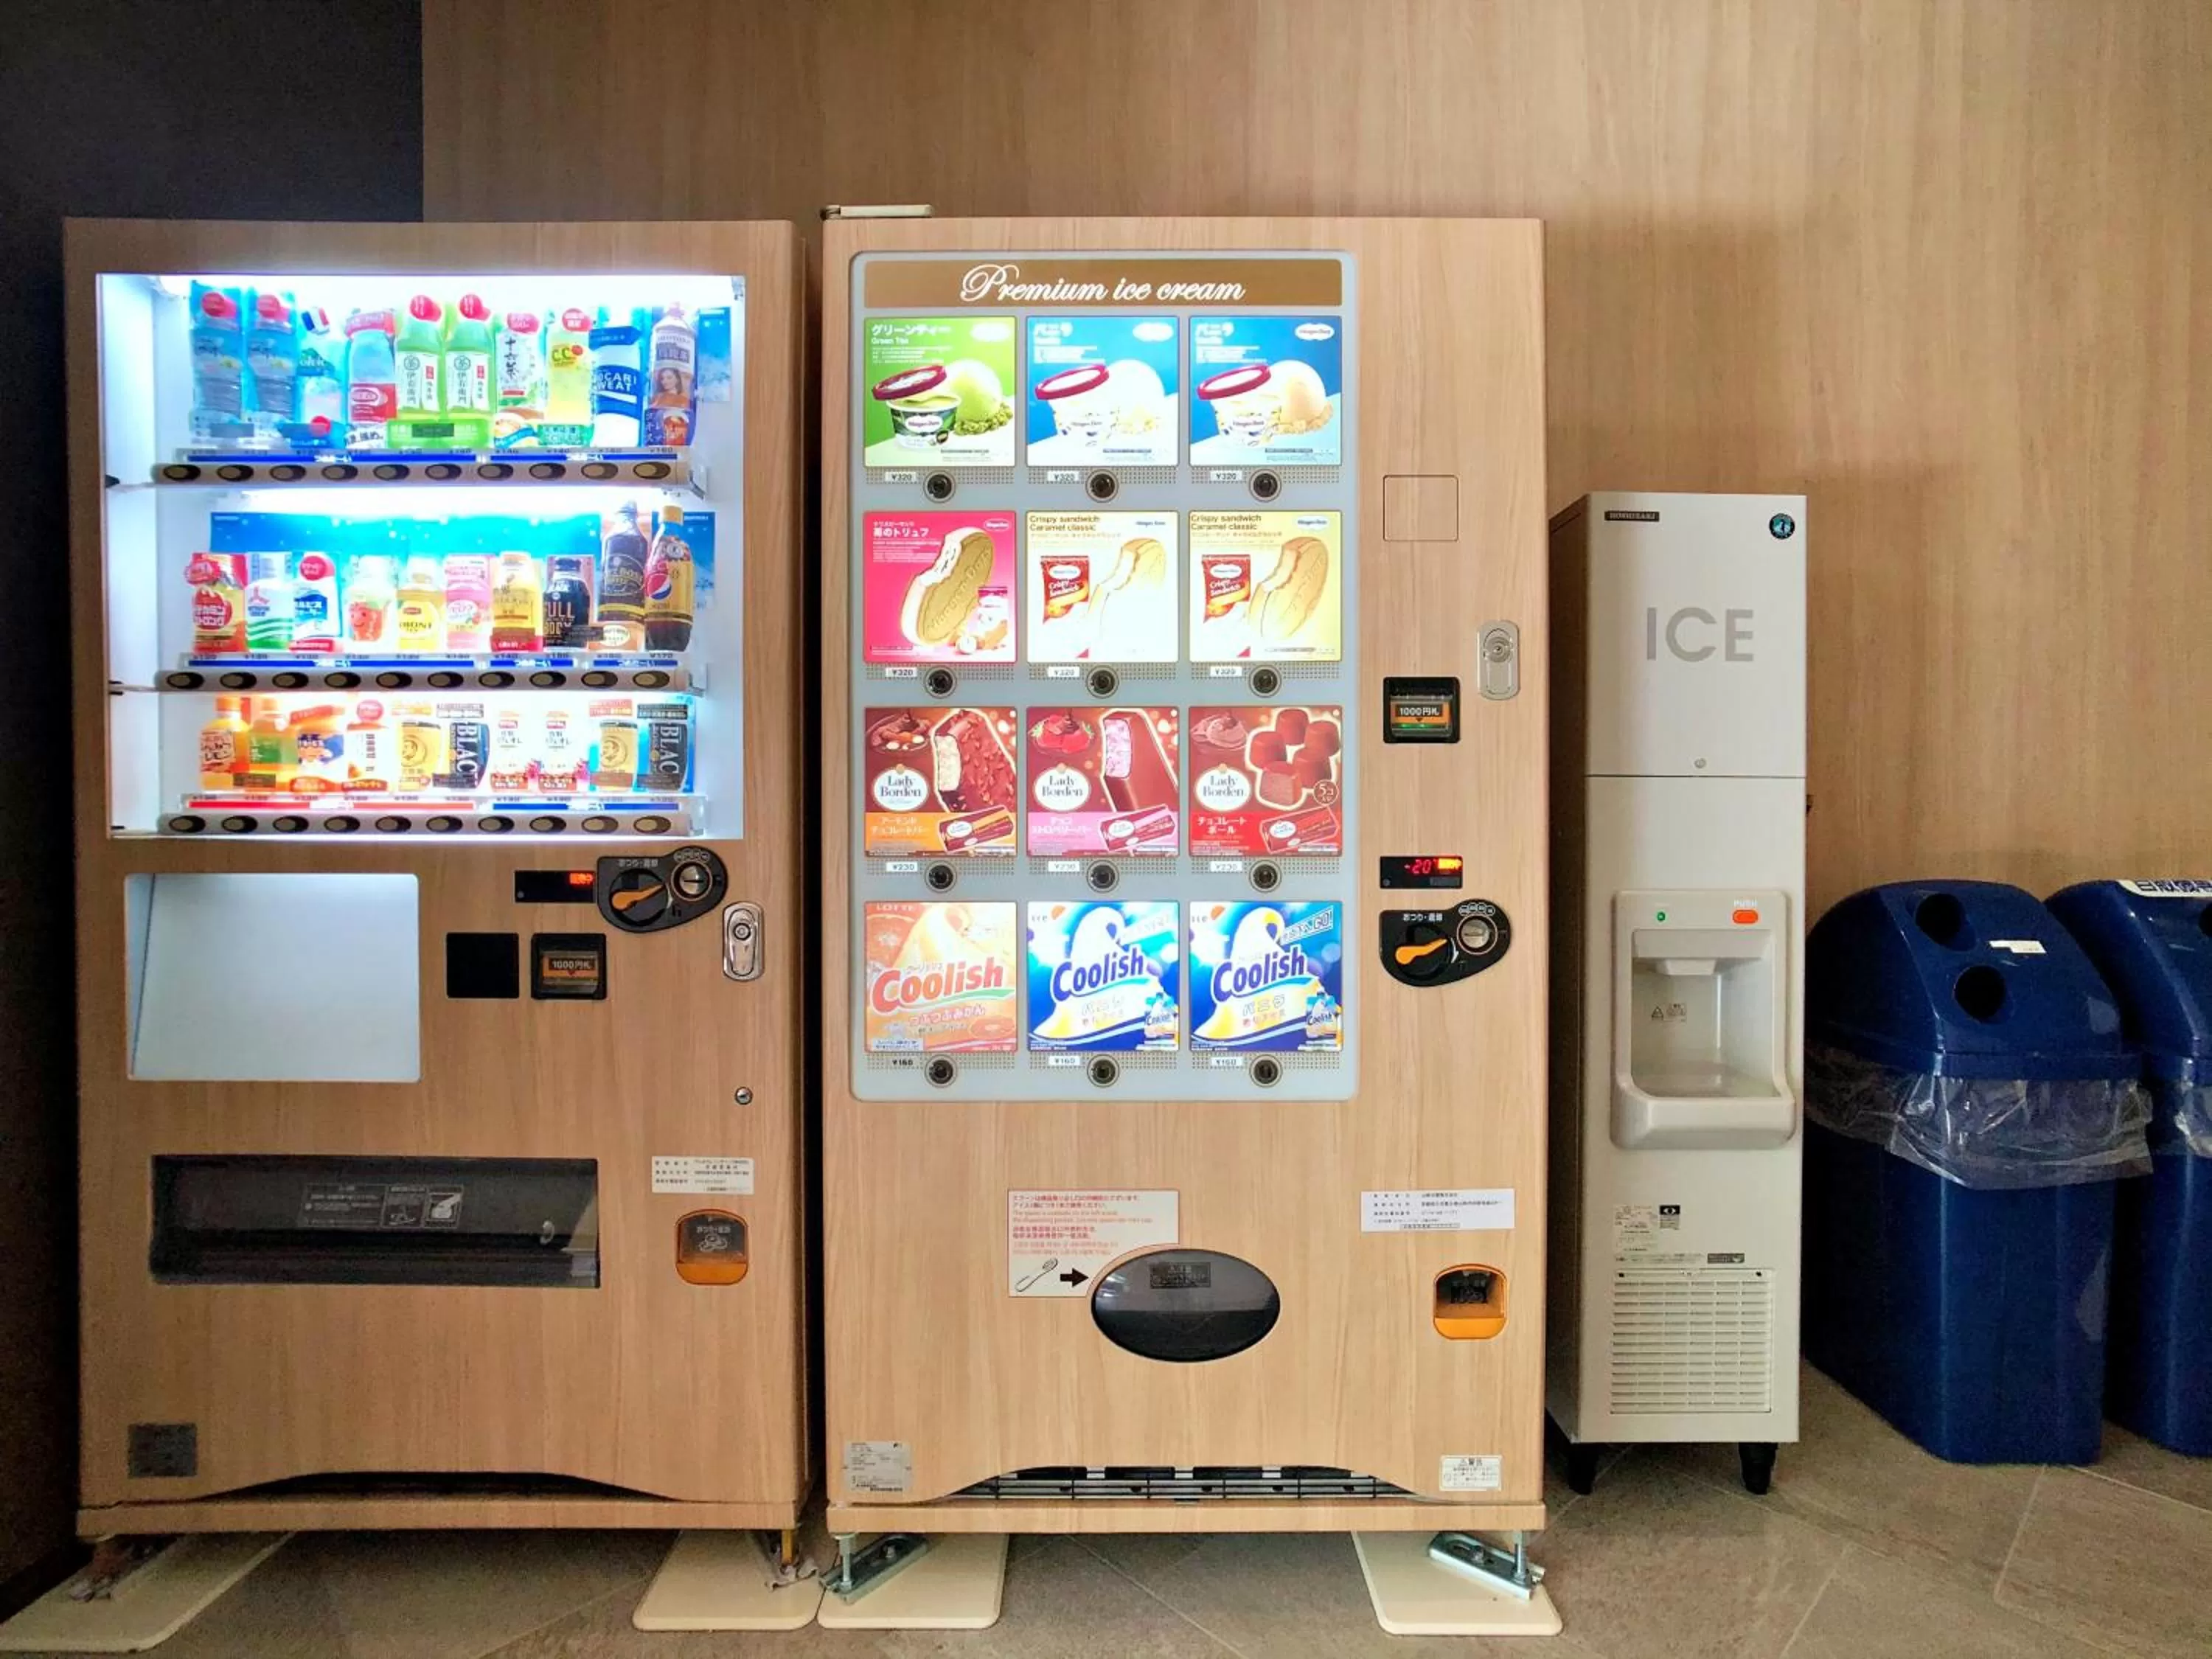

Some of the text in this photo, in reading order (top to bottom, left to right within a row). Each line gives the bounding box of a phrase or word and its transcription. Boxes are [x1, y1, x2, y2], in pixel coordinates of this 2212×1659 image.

[960, 264, 1246, 302] Premium ice cream
[891, 473, 913, 481] ¥320
[1191, 515, 1219, 523] Crispy
[1646, 607, 1754, 662] ICE
[1399, 706, 1440, 717] 1000円札
[659, 726, 679, 776] BLAC
[887, 775, 914, 787] Lady
[1049, 775, 1076, 787] Lady
[1210, 775, 1239, 787] Lady
[880, 785, 922, 798] Borden
[1042, 785, 1084, 797] Borden
[1203, 786, 1245, 797] Borden
[1196, 816, 1247, 826] チョコレート
[1052, 947, 1144, 1002] Coolish
[1213, 946, 1305, 1002] Coolish
[872, 956, 1004, 1014] Coolish
